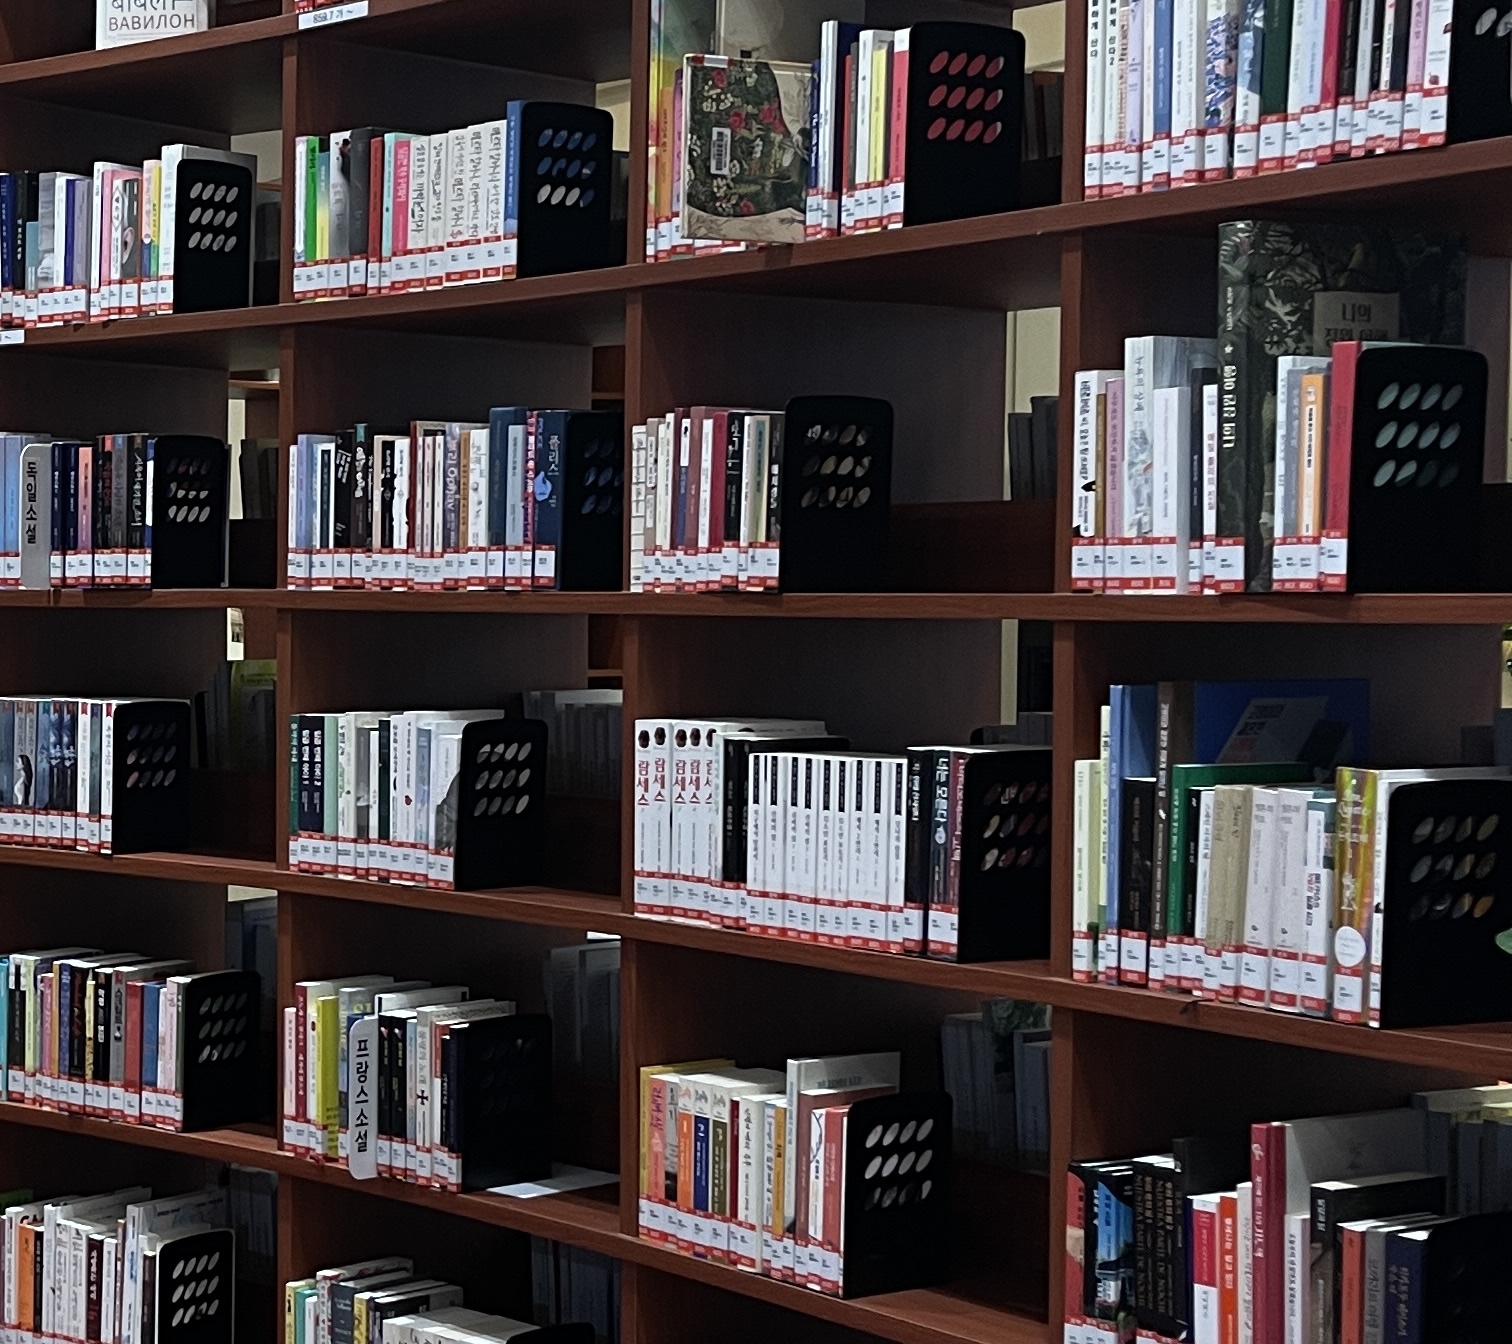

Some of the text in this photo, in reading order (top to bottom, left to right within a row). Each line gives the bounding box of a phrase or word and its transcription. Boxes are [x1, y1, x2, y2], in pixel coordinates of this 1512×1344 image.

[108, 13, 196, 33] ВАВИЛОН
[25, 461, 38, 545] 독일소설
[636, 759, 650, 806] 람세스
[653, 756, 667, 803] 람세스
[673, 759, 687, 805] 람세스
[688, 759, 701, 805] 람세스
[934, 757, 949, 824] 너는 모른다
[354, 1038, 371, 1153] 프랑스소설
